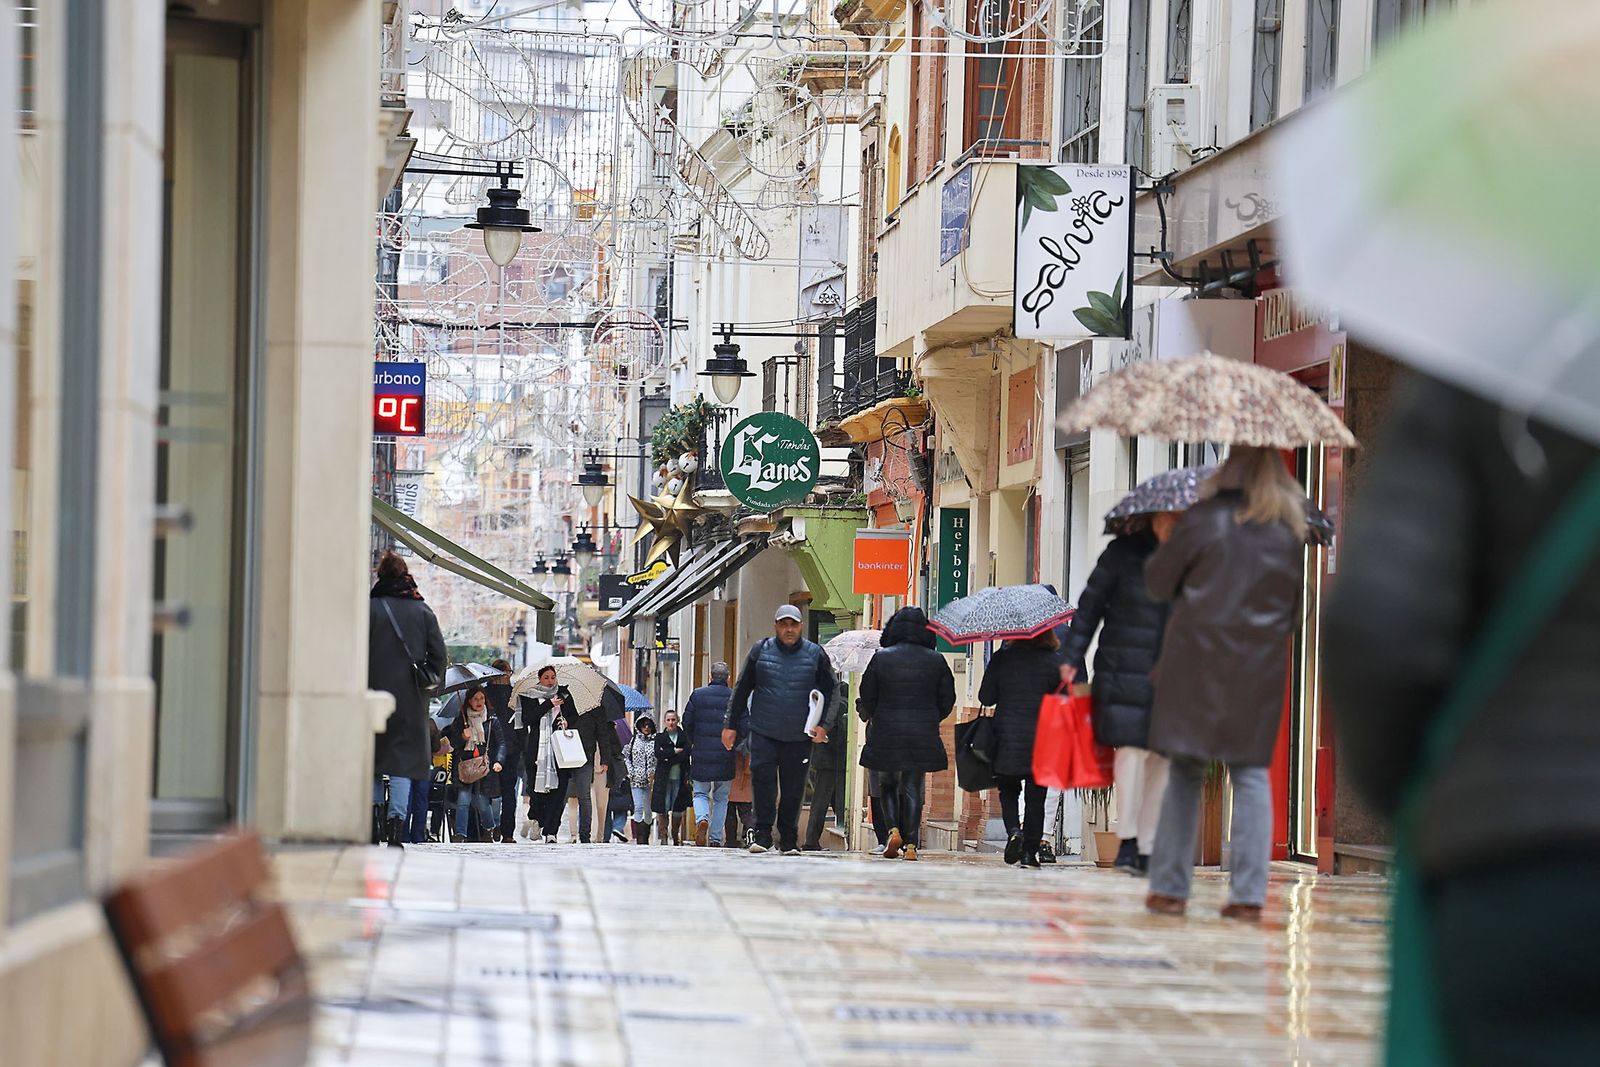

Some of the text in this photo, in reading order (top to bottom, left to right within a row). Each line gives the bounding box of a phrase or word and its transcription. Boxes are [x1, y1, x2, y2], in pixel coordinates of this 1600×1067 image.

[1076, 168, 1128, 179] Desde 1992
[1021, 189, 1124, 330] salvia
[745, 496, 770, 508] Fundada
[858, 561, 904, 570] bankinter
